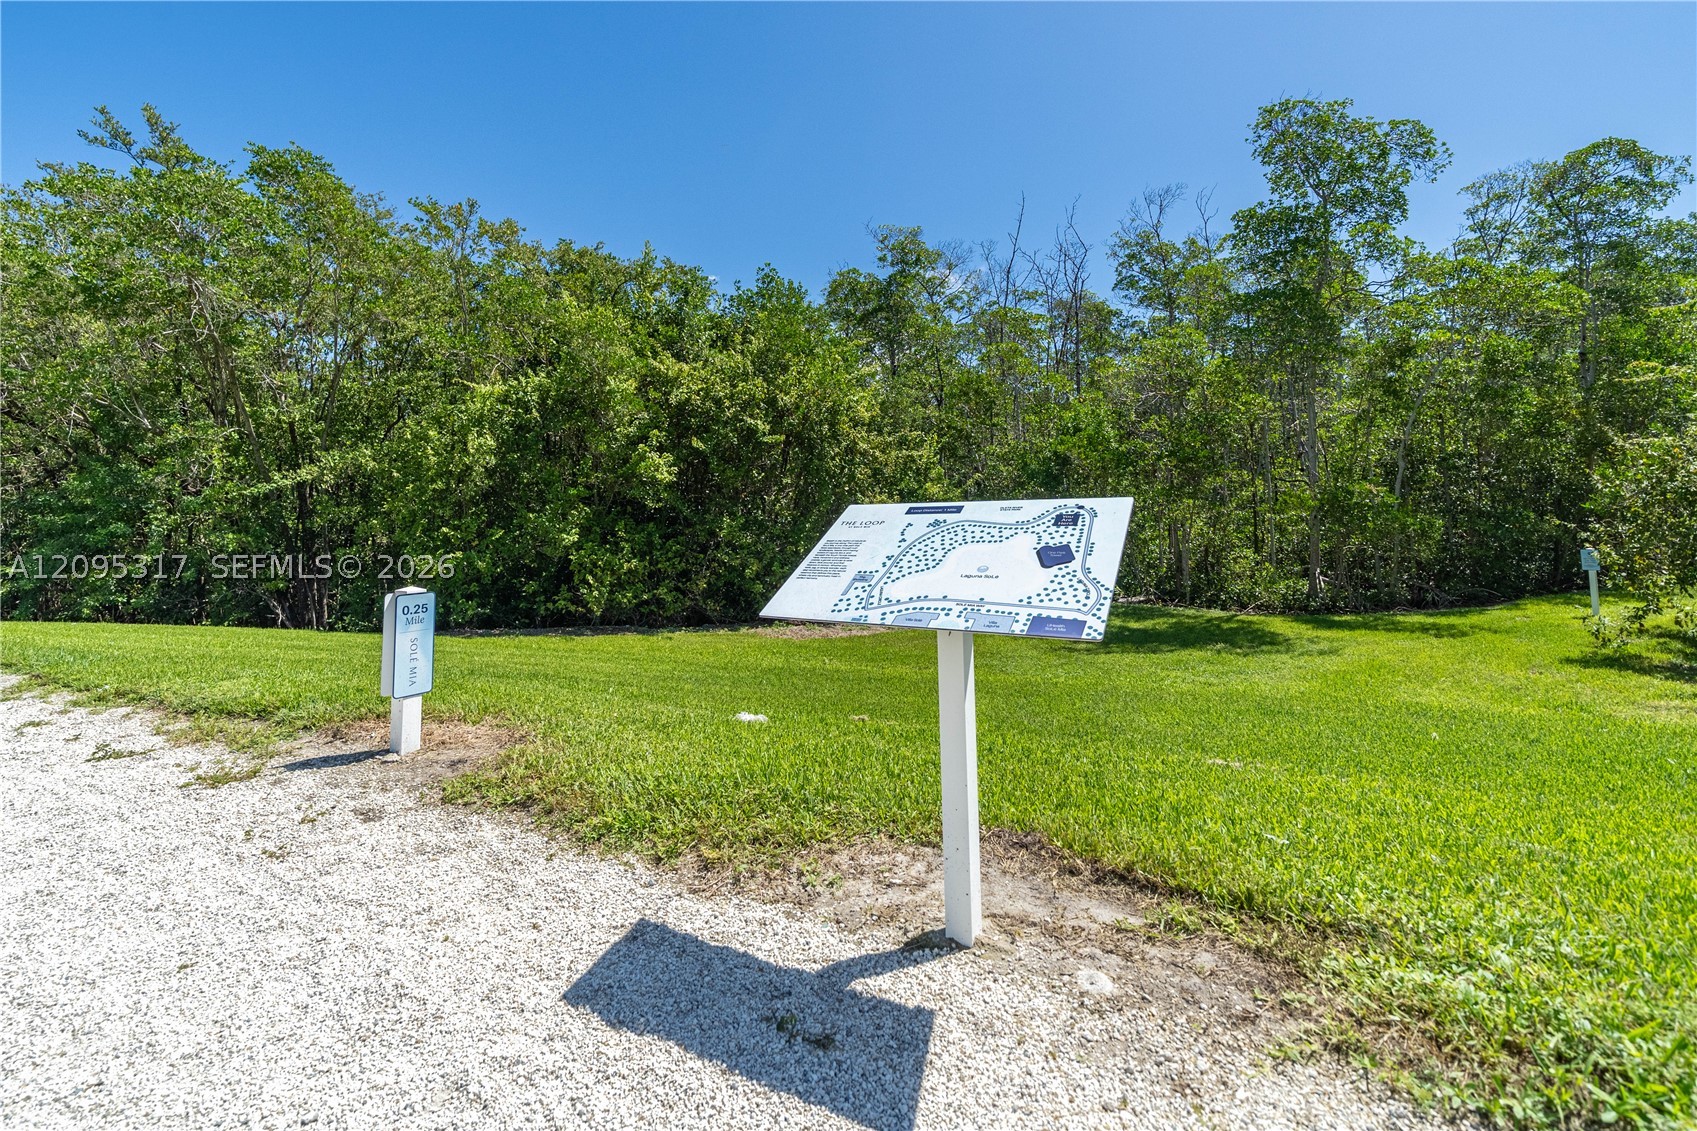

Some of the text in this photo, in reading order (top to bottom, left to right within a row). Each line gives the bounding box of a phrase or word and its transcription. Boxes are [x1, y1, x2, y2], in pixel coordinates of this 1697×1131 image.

[402, 603, 429, 616] 0.25
[405, 616, 425, 626] Mile
[409, 637, 419, 687] SOLÉ MIA
